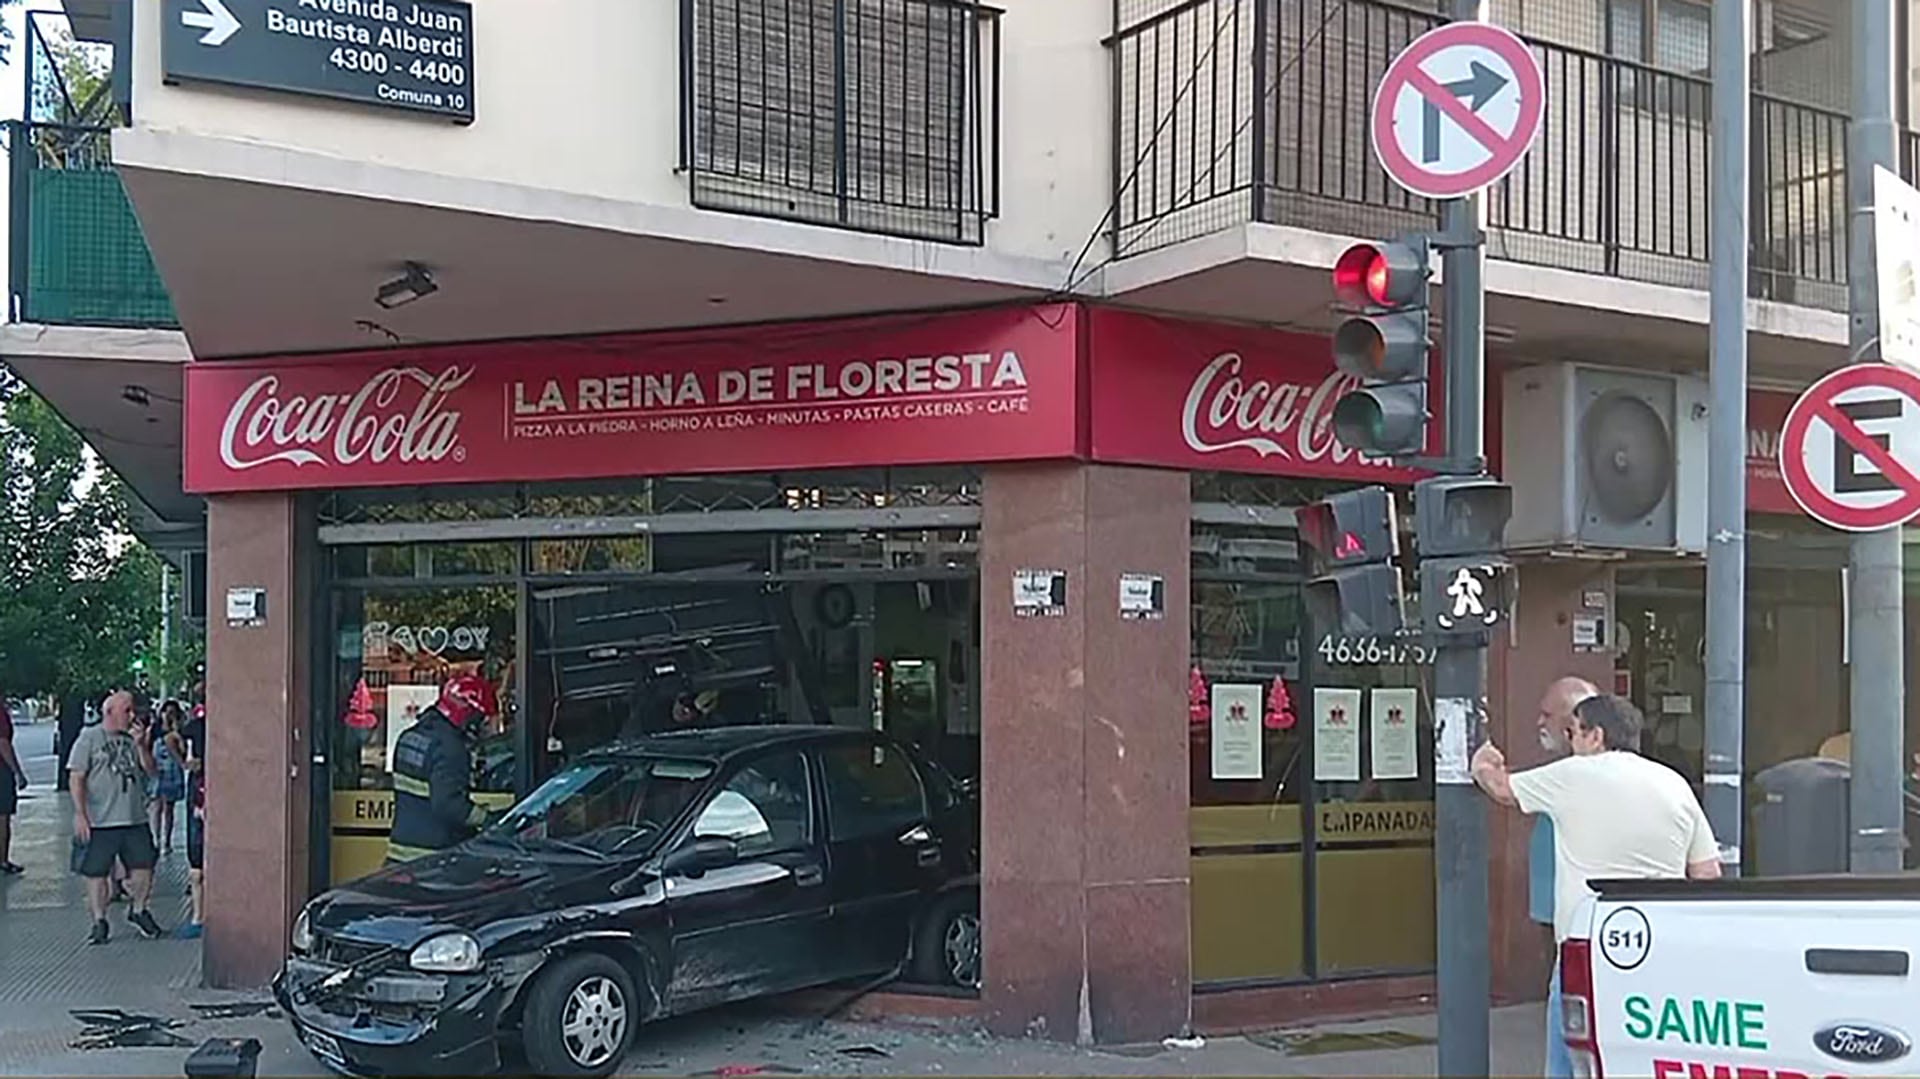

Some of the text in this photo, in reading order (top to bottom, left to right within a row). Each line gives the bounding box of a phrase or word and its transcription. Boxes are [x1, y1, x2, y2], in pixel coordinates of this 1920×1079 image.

[267, 10, 463, 58] Bautista Alberdi
[405, 5, 462, 32] Juan
[330, 48, 387, 73] 4300
[409, 60, 464, 85] 4400
[378, 84, 464, 108] Comuna 10
[514, 351, 1027, 414] LA REINA DE FLORESTA
[220, 365, 475, 469] Coca-Cola
[514, 424, 550, 438] PIZZA
[554, 424, 566, 436] A
[568, 422, 585, 436] LA
[589, 419, 637, 434] PIEDRA
[650, 416, 700, 432] HORNO
[703, 416, 714, 429] A
[718, 412, 754, 428] LEÑA
[767, 411, 831, 425] MINUTAS
[844, 405, 900, 421] PASTAS
[903, 400, 973, 418] CASERAS
[987, 397, 1028, 413] CAFÉ
[1182, 353, 1394, 467] Coca-C
[1608, 929, 1643, 948] 511
[1625, 995, 1768, 1050] SAME
[1831, 1025, 1884, 1057] Ford
